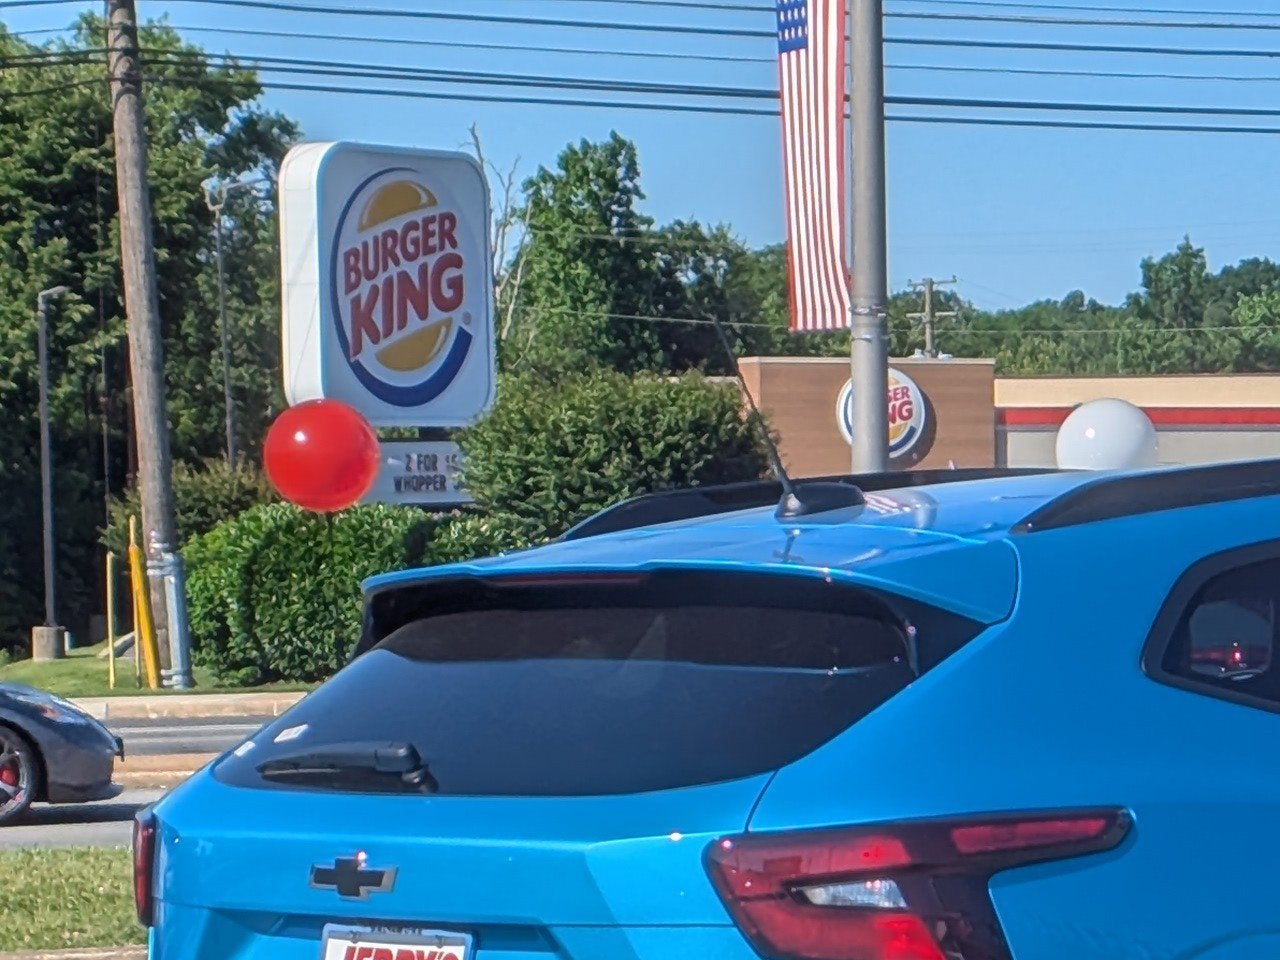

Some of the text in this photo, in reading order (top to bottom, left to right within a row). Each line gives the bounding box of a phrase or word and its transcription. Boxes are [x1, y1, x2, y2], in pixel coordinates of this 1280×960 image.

[343, 211, 458, 296] BURGER
[350, 252, 464, 358] KING
[886, 385, 911, 402] GER
[886, 400, 914, 425] NG
[416, 453, 438, 472] FOR
[393, 474, 447, 492] WHOPPER
